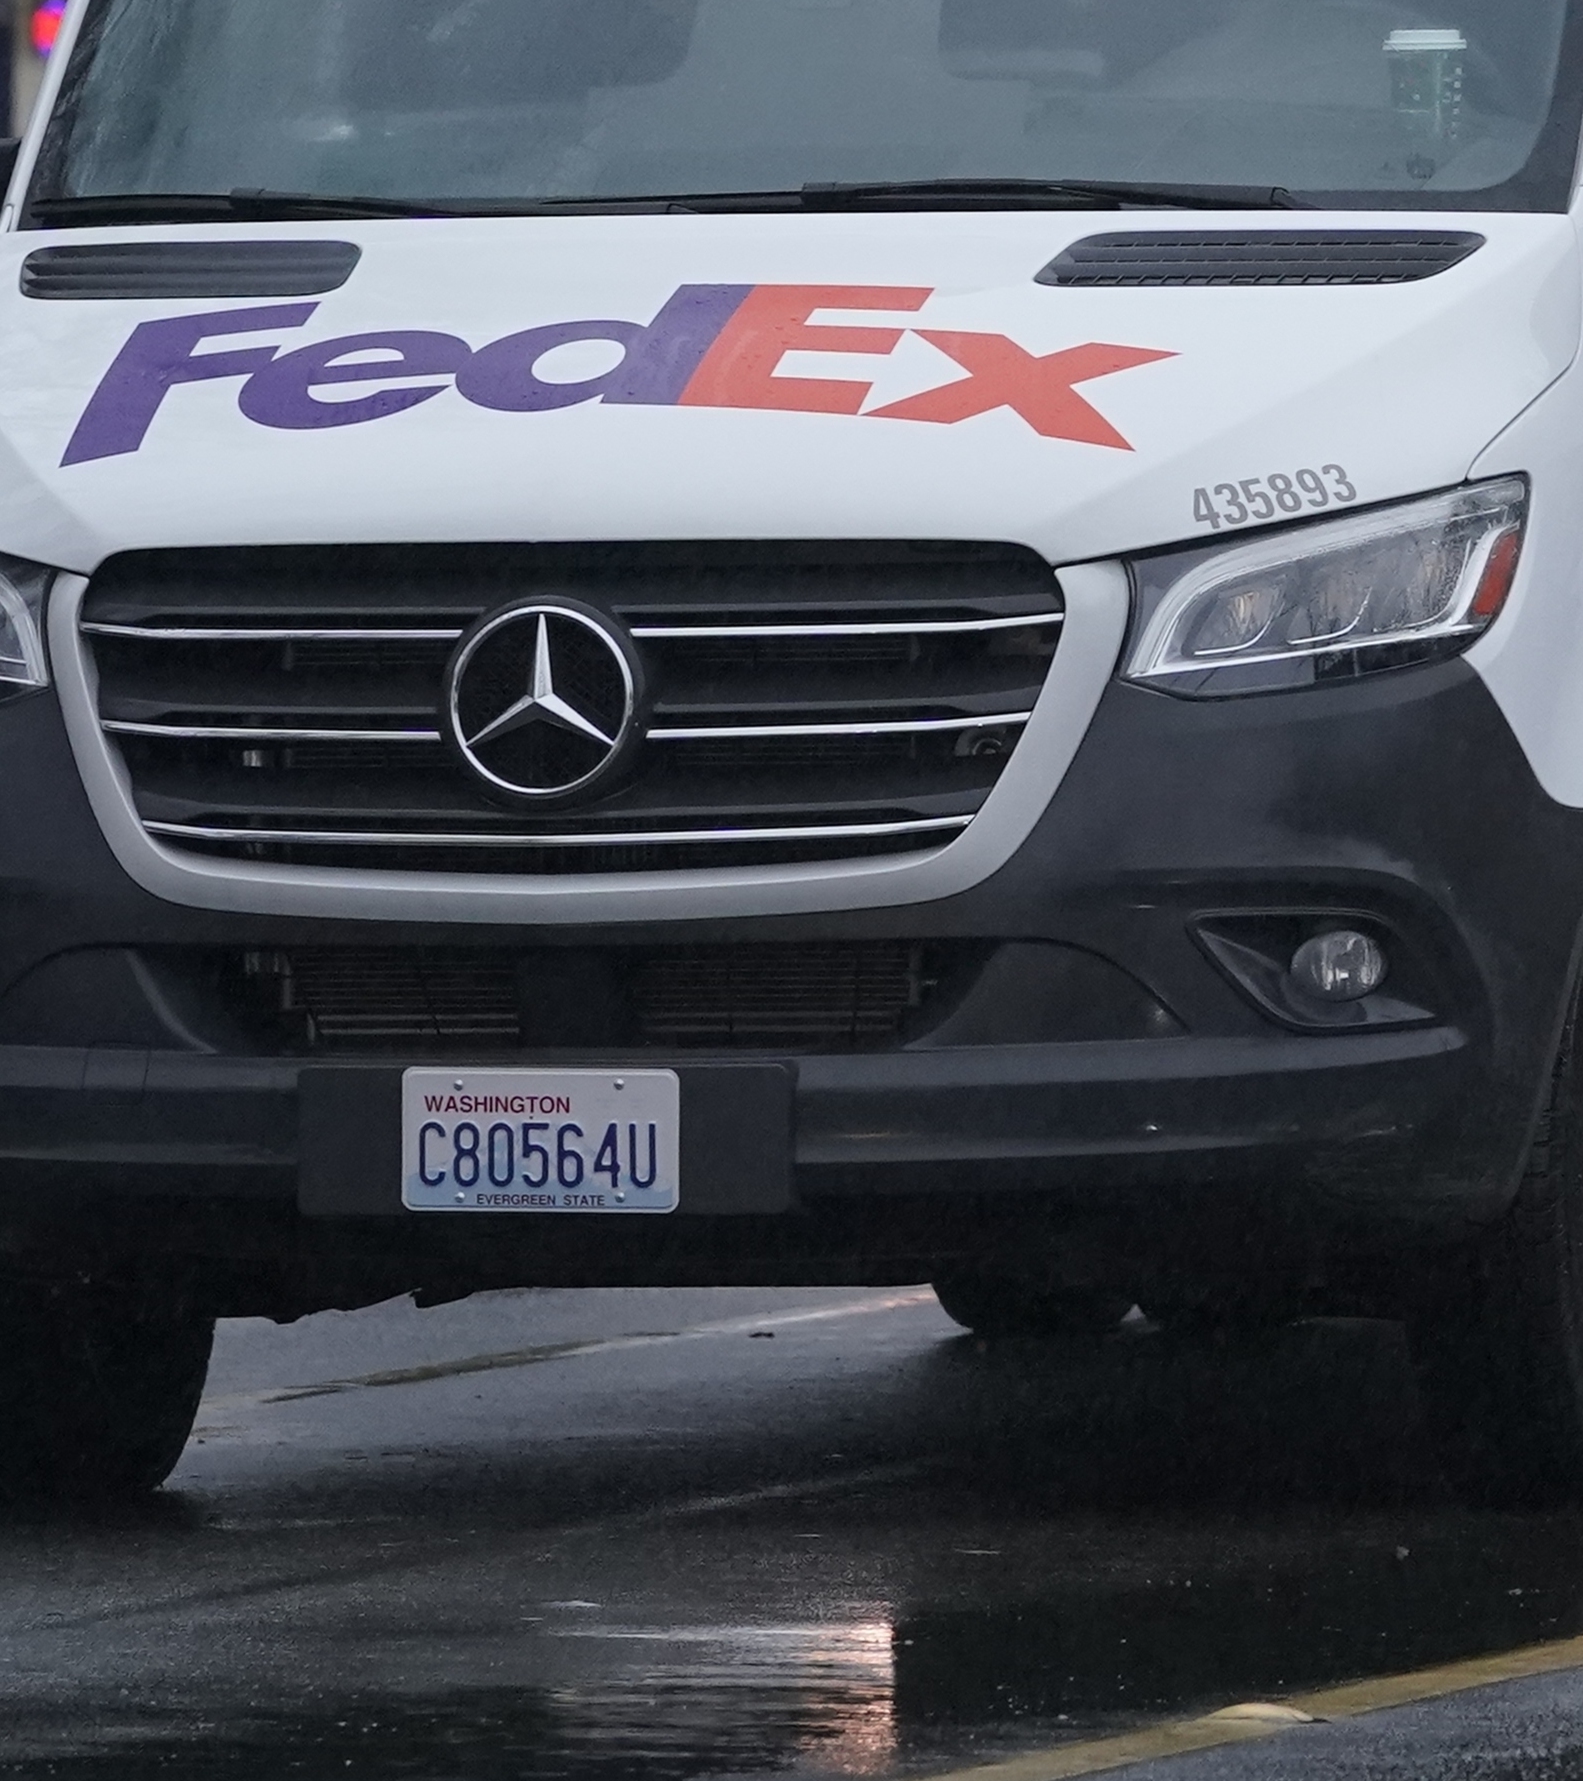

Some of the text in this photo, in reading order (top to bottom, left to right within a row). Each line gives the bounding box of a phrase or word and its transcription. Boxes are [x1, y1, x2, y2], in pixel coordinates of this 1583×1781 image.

[58, 283, 1182, 468] FedEx
[1193, 464, 1357, 530] 435893
[424, 1095, 571, 1114] WASHINGTON
[418, 1121, 657, 1189] C80564U
[476, 1193, 606, 1207] EVERGREEN STATE
